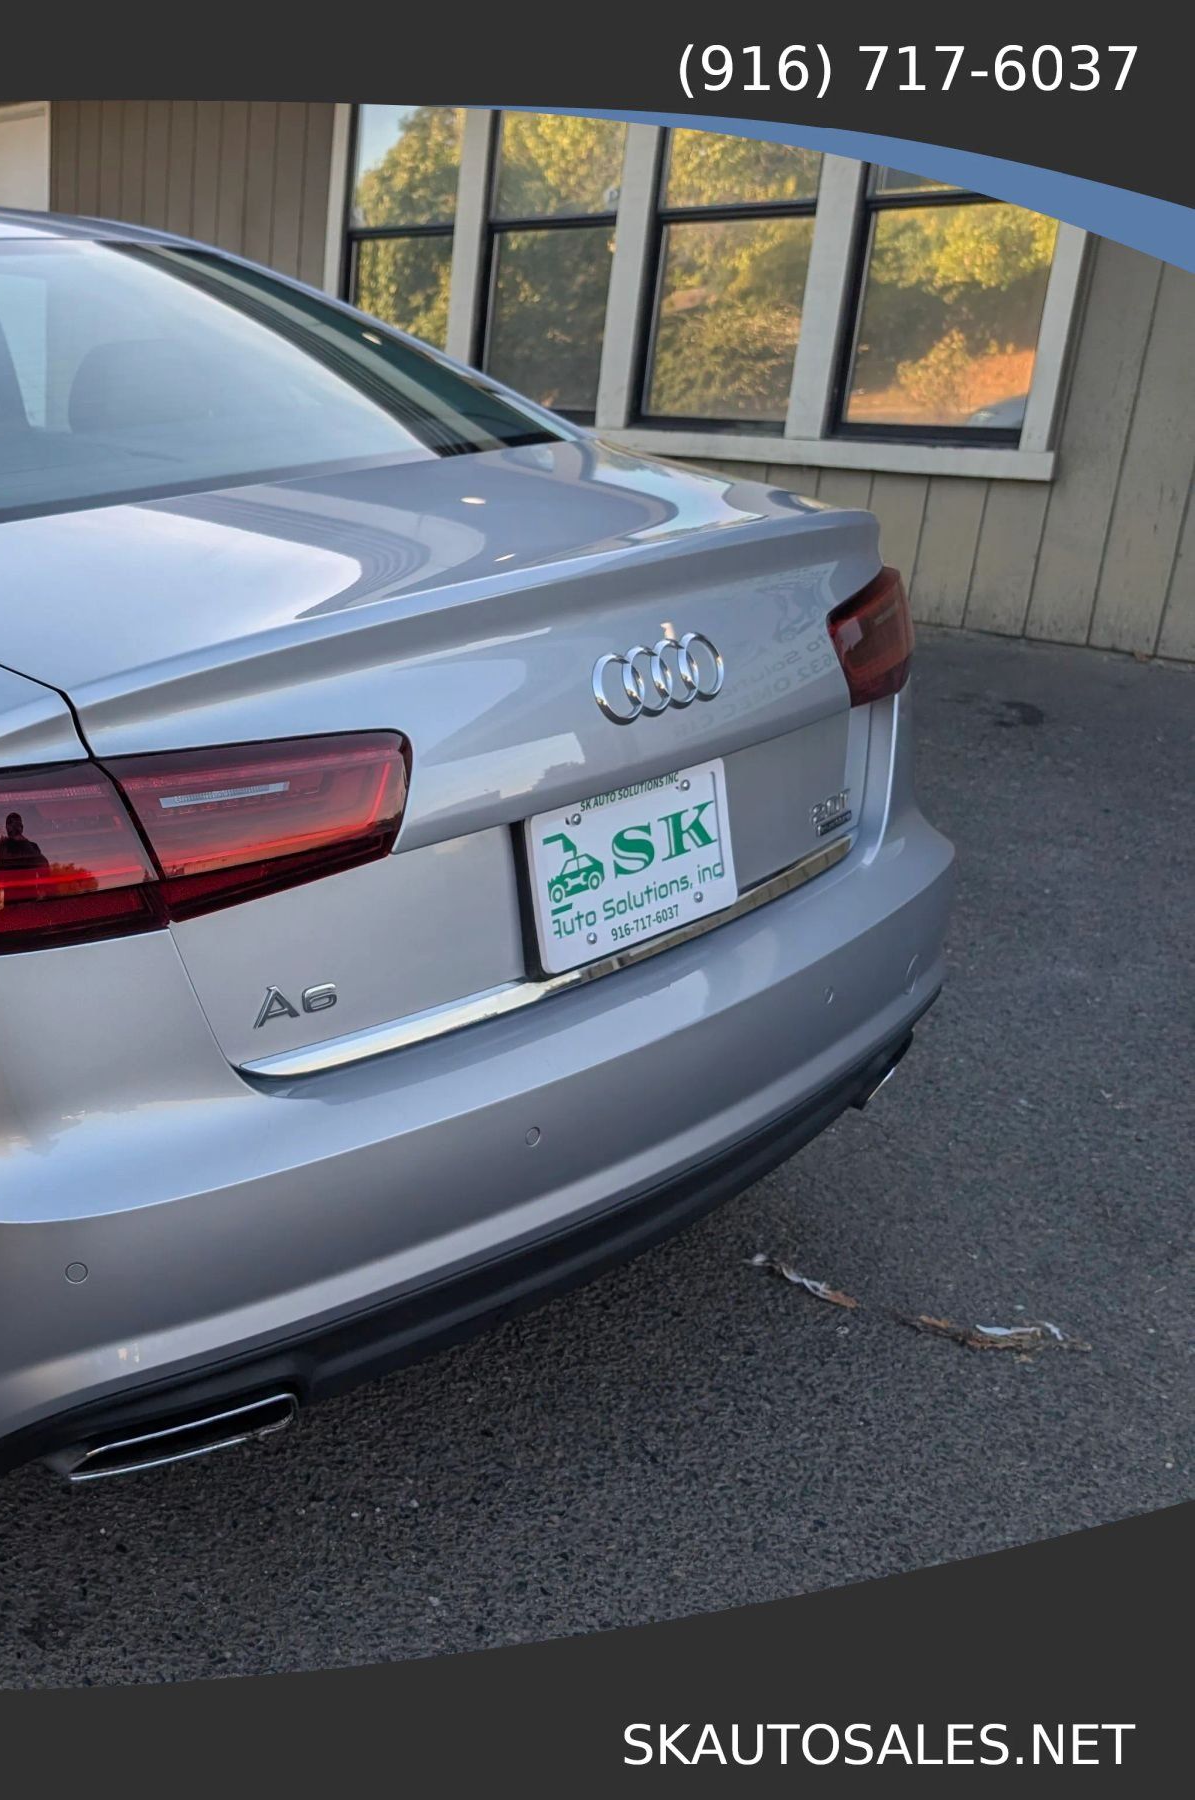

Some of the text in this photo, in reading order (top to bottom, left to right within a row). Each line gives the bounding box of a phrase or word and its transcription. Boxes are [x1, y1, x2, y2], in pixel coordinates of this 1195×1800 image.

[580, 772, 680, 812] SK AUTO SOLUTIONS INC
[611, 799, 718, 879] SK
[602, 874, 694, 922] Solutions,
[697, 862, 725, 885] inc
[611, 904, 680, 942] 916-717-6037
[252, 981, 338, 1029] A6
